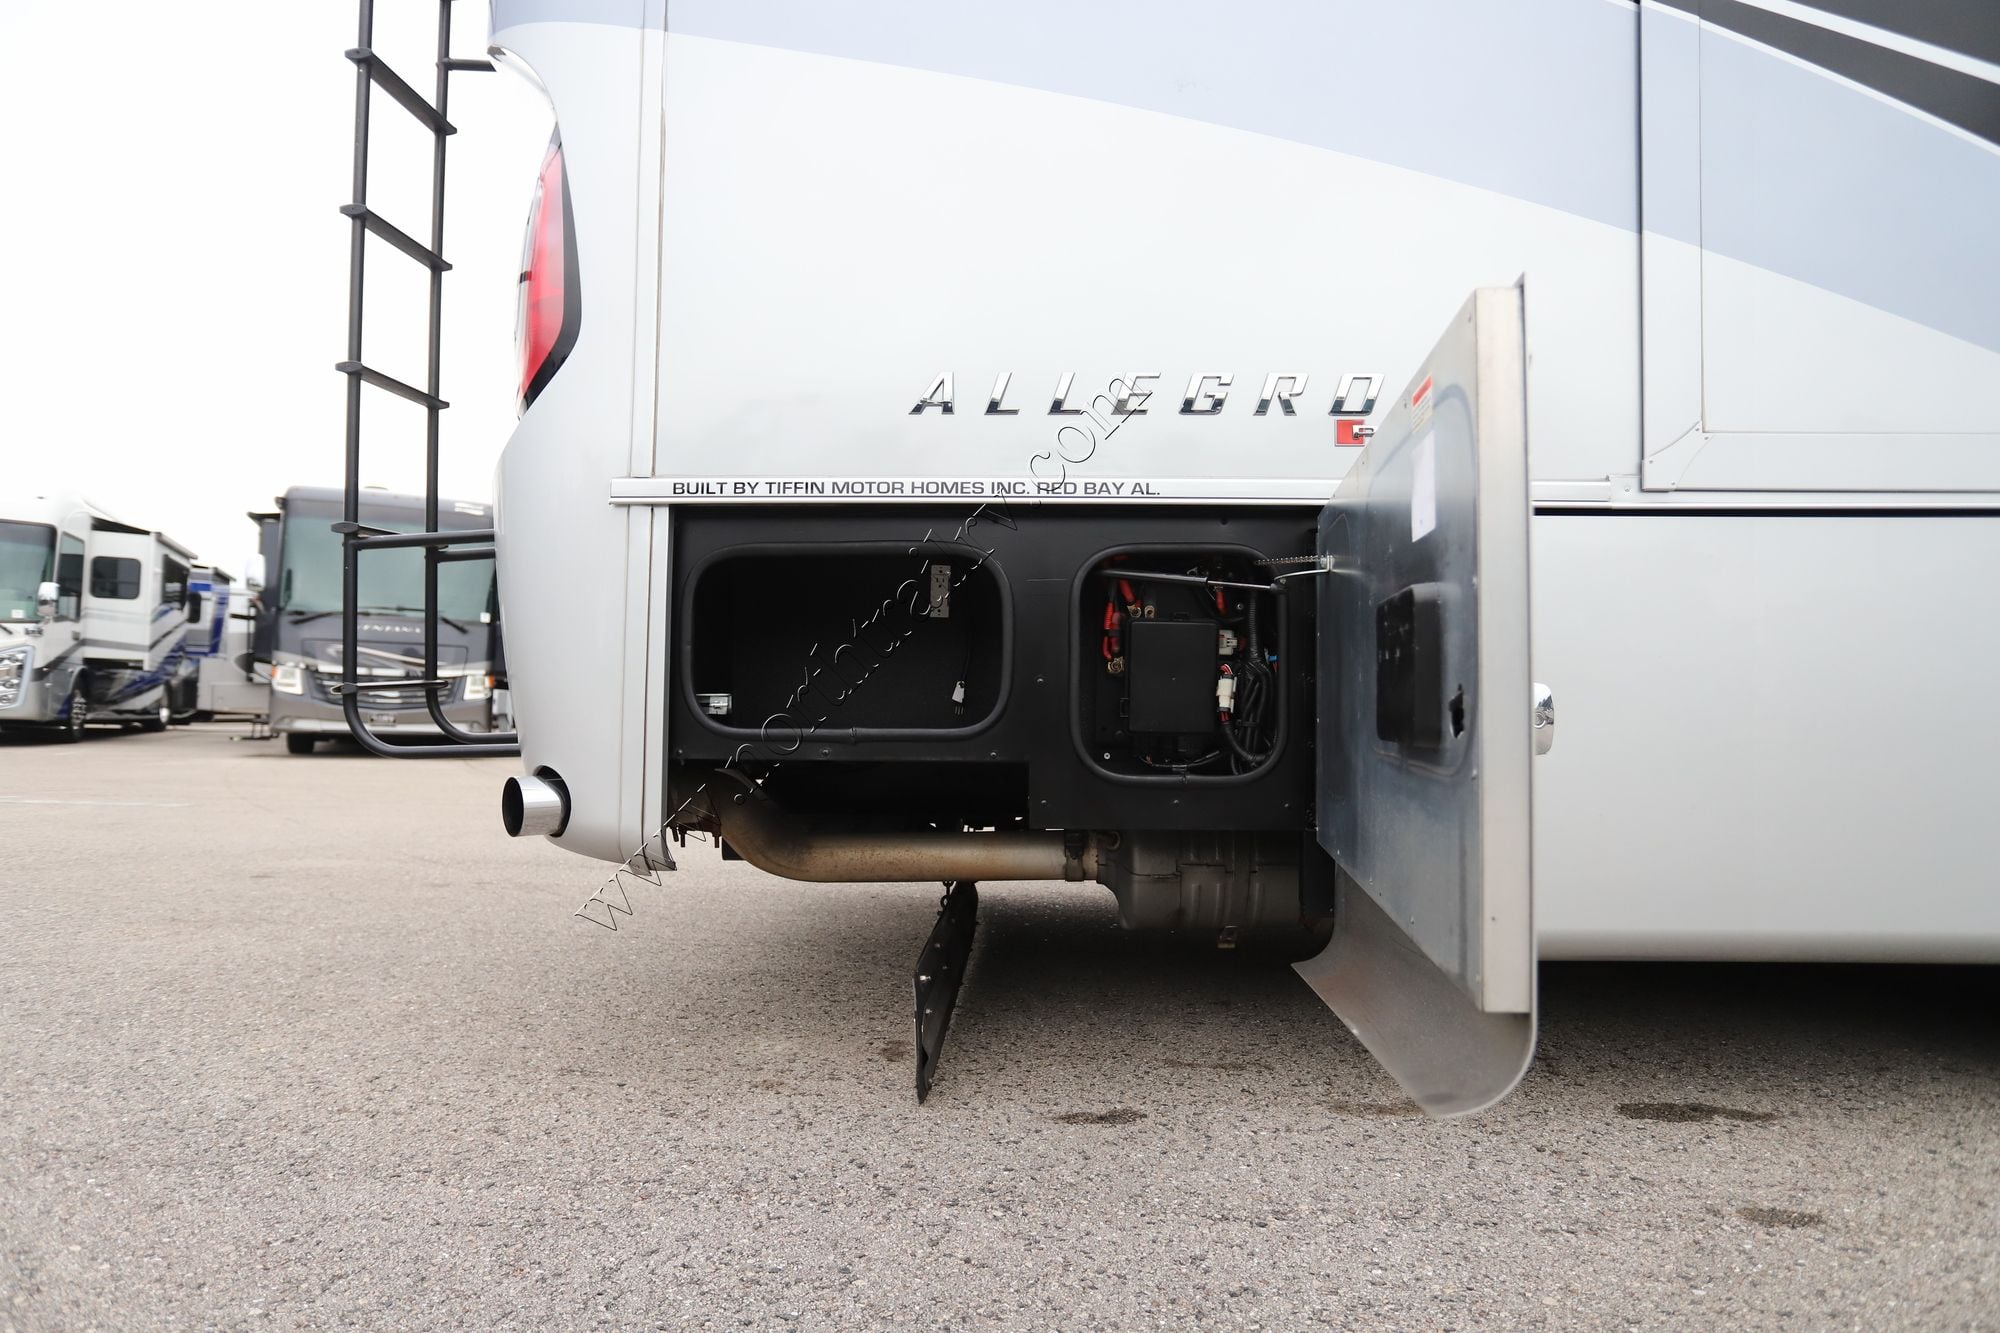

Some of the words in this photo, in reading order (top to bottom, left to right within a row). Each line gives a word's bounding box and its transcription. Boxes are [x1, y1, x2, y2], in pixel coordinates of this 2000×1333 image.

[908, 371, 1386, 417] ALLEGRO
[672, 481, 728, 495] BUILT
[733, 481, 760, 495] BY
[764, 481, 825, 495] TIFFIN
[831, 481, 904, 495] MOTOR
[910, 481, 985, 495] HOMES
[991, 481, 1030, 495] INC.
[1036, 481, 1078, 495] RED
[1084, 481, 1125, 495] BAY
[1130, 481, 1161, 496] AL.
